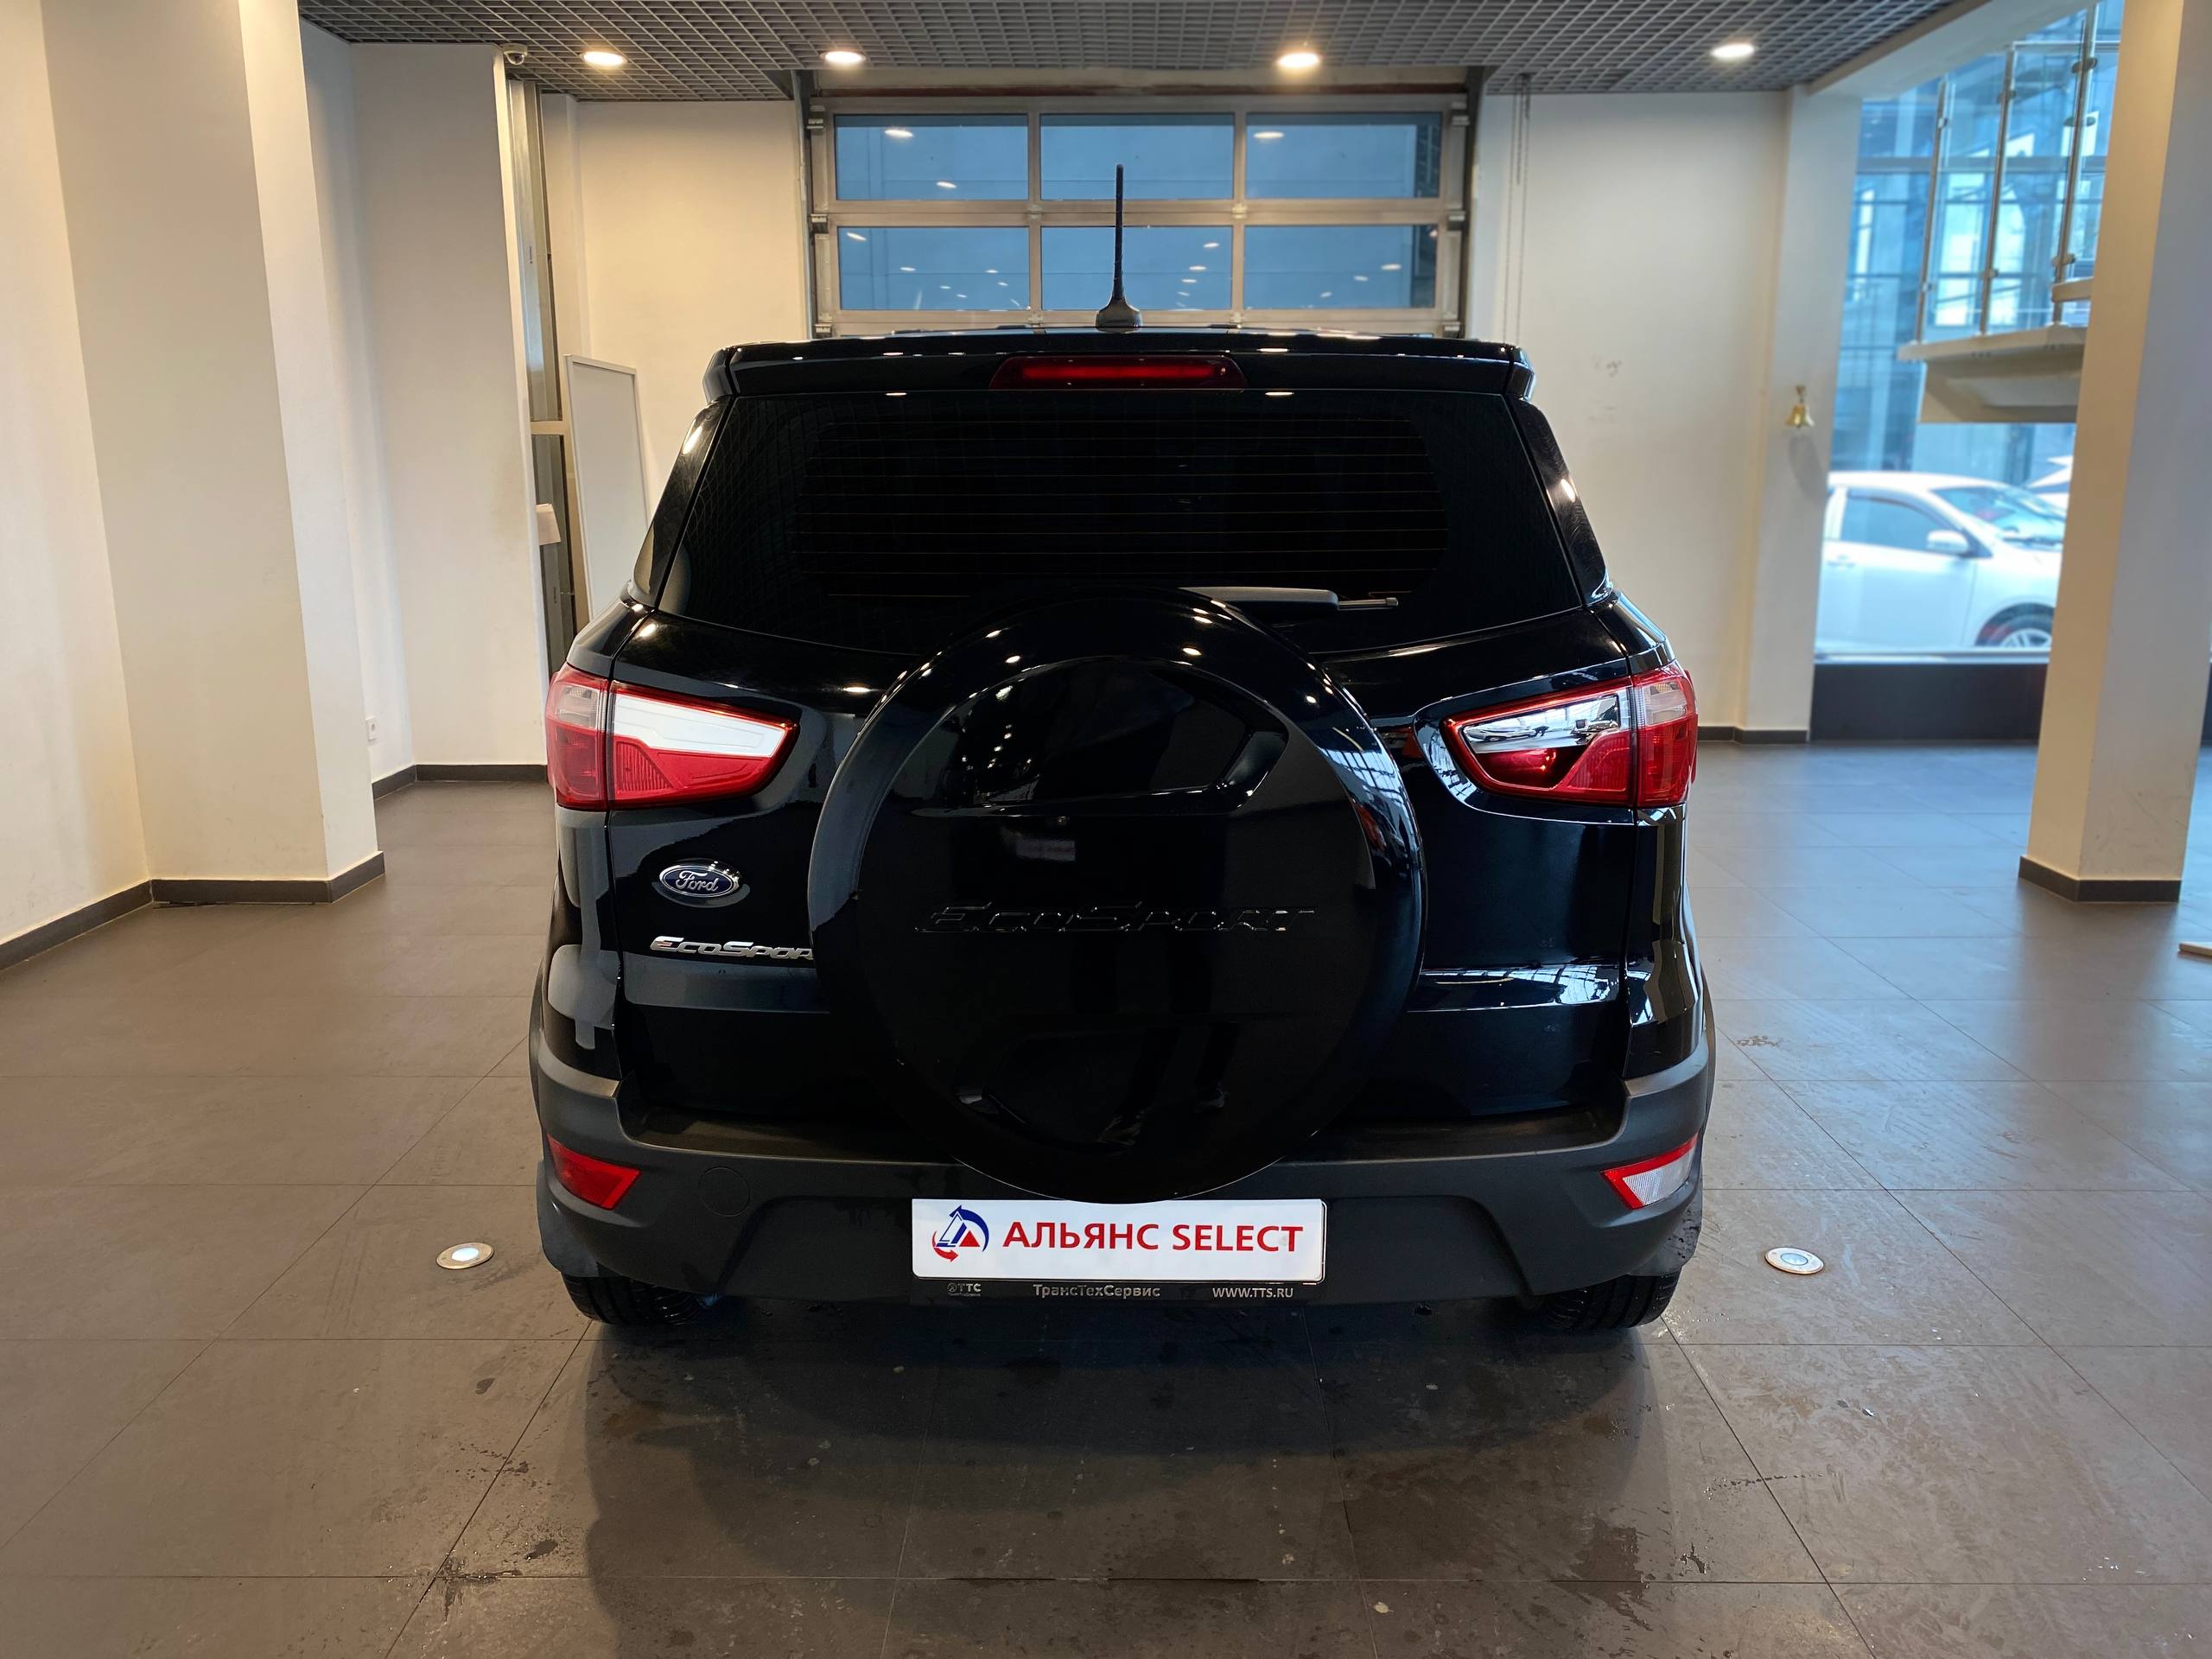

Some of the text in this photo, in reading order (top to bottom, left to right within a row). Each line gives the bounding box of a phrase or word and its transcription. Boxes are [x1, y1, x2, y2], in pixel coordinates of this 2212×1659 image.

[675, 869, 719, 893] Ford
[649, 935, 815, 961] EcoSpor
[1002, 1220, 1304, 1253] АЛЬЯНС SELECT
[1033, 1283, 1160, 1299] ТрансТехСервис
[1211, 1287, 1294, 1299] WWW.TTS.RU
